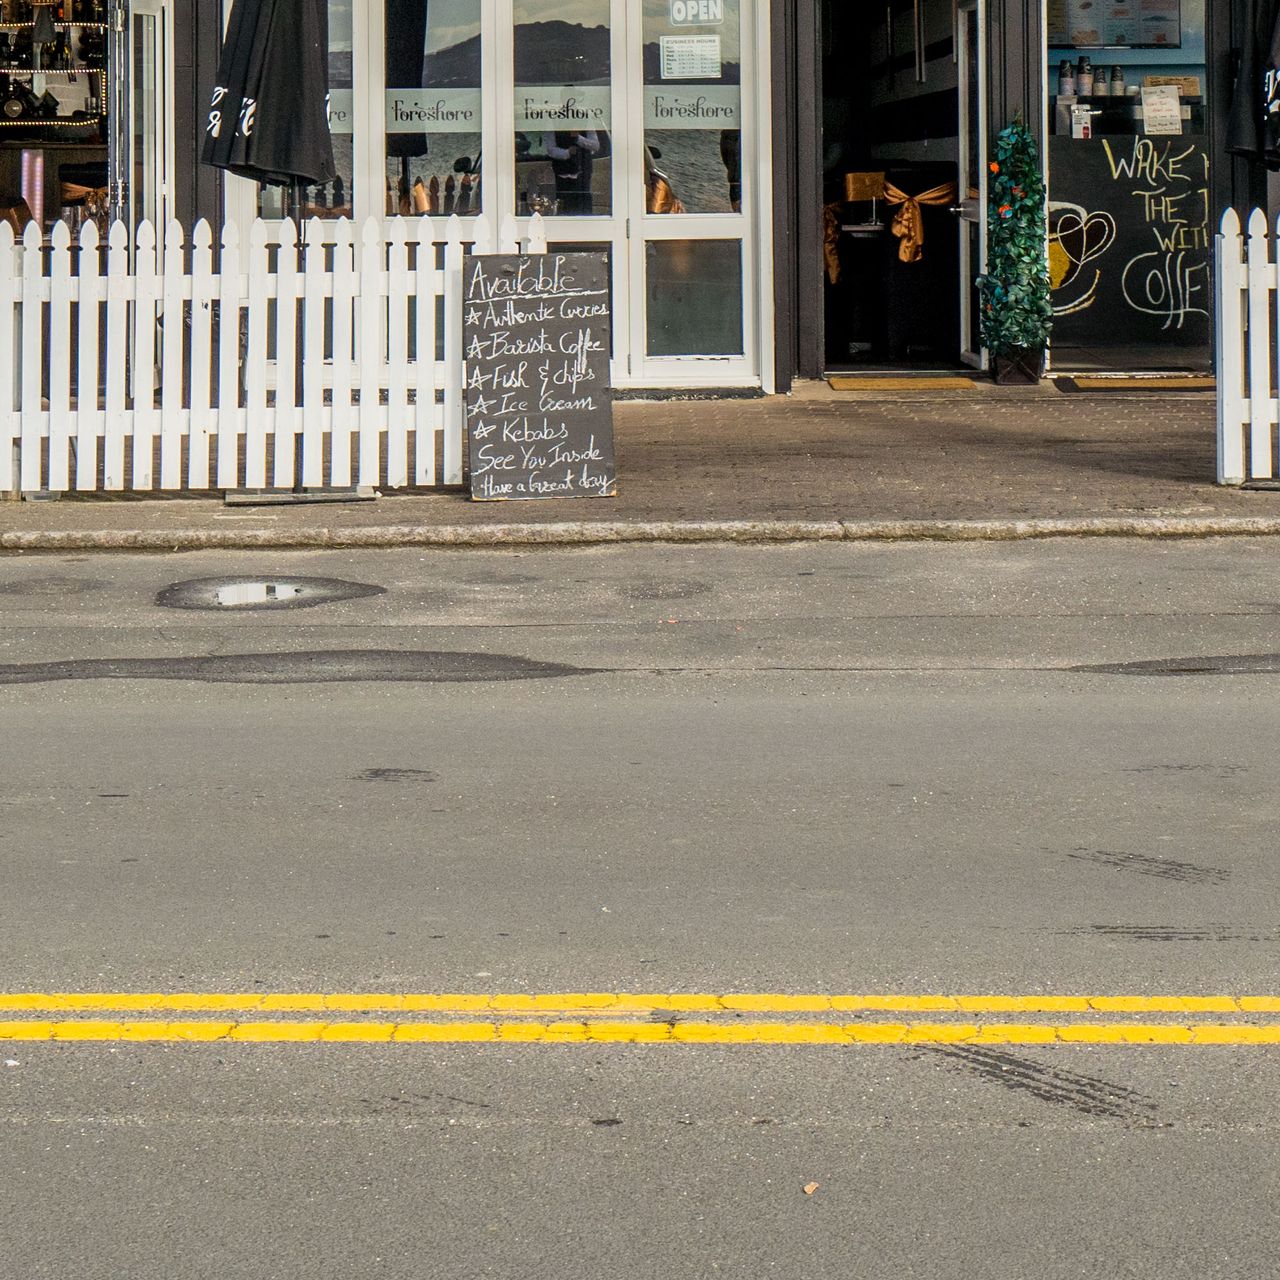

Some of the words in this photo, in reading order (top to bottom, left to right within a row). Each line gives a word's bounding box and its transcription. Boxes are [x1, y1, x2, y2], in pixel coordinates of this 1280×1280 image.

[672, 0, 722, 22] OPEN
[392, 99, 473, 122] Foreshore
[523, 97, 604, 121] Foreshore
[652, 96, 734, 119] Foreshore
[1101, 135, 1195, 186] WAKE
[1132, 187, 1192, 224] THE
[469, 255, 583, 299] Available
[483, 300, 556, 329] Authentic
[560, 297, 610, 319] Curries
[486, 328, 557, 359] Barista
[559, 327, 606, 374] Coffee
[492, 360, 530, 390] Fish
[493, 391, 529, 416] Ice
[539, 390, 598, 413] Cream
[502, 417, 569, 443] Kebabs
[470, 444, 517, 475] See
[520, 445, 547, 469] You
[548, 434, 605, 468] Inside
[483, 474, 513, 497] Have
[516, 482, 527, 492] a
[528, 471, 575, 494] Great
[578, 463, 616, 495] day
